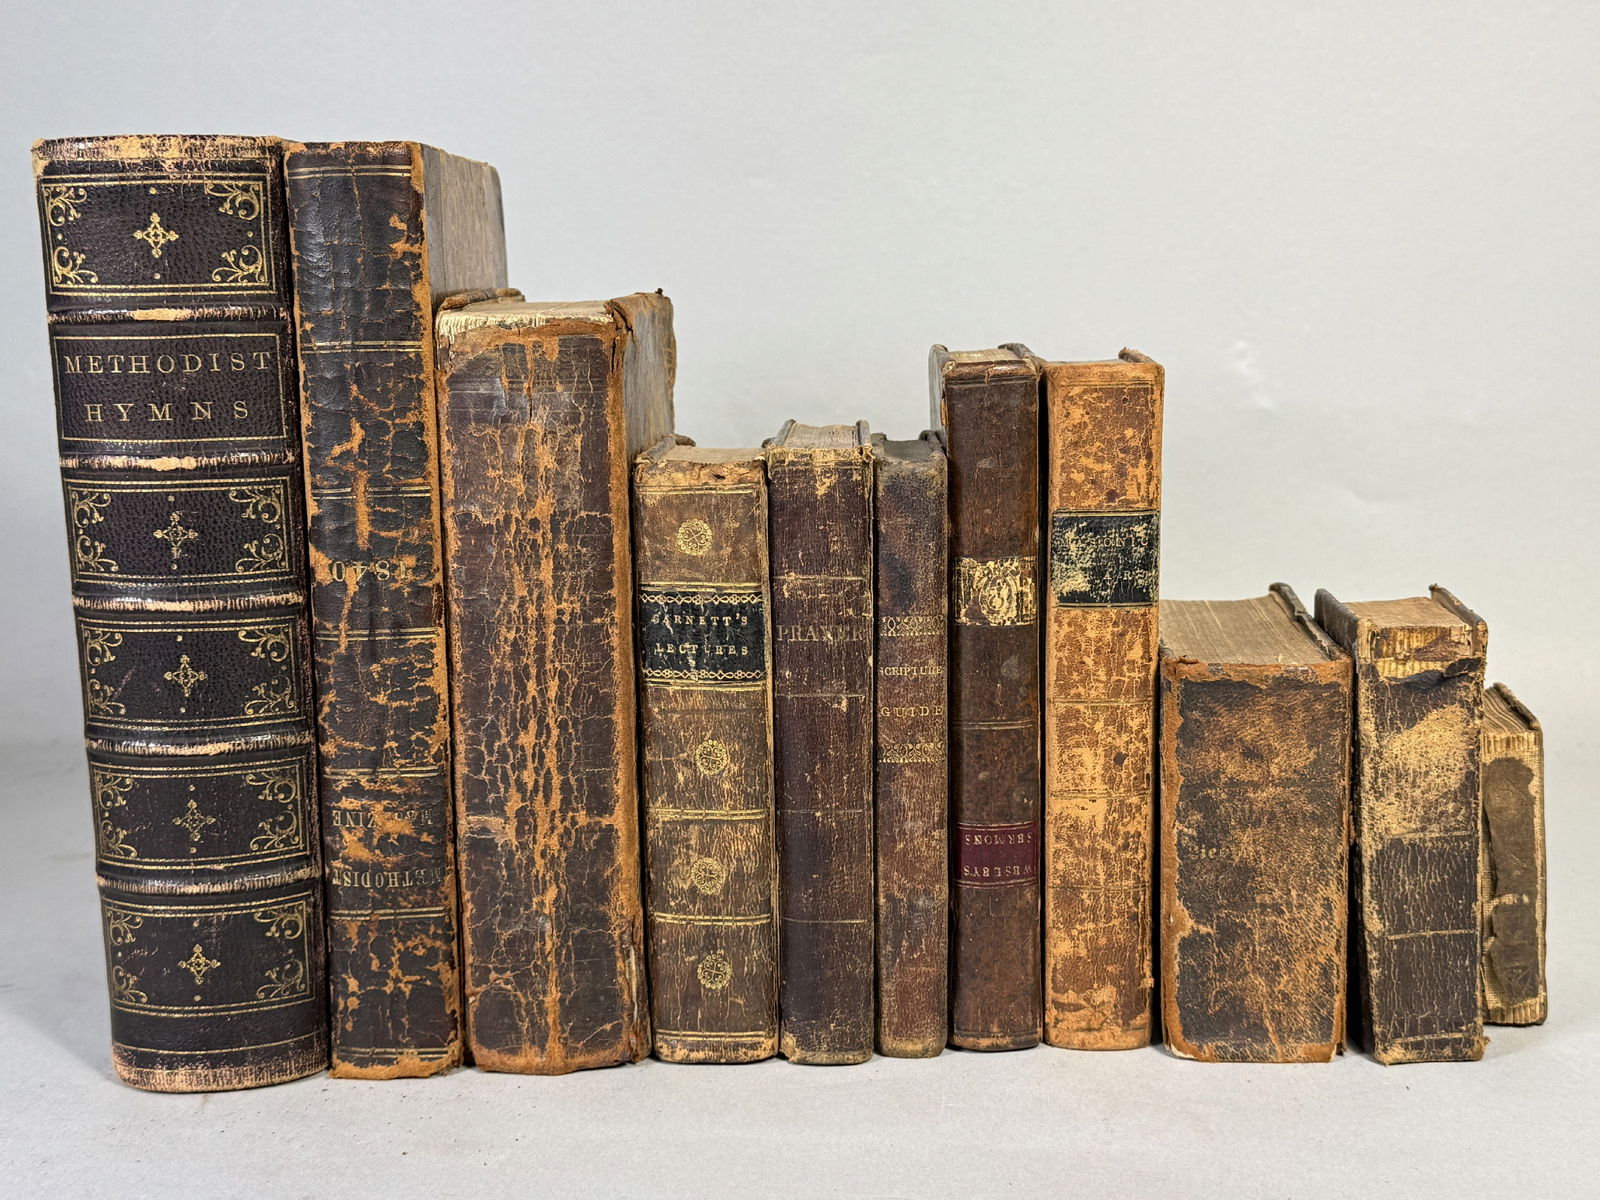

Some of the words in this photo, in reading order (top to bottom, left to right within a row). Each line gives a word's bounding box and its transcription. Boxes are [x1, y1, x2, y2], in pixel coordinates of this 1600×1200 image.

[64, 351, 271, 374] METHODIST
[84, 400, 249, 423] HYMNS
[331, 560, 407, 583] 1840
[651, 613, 748, 626] GARNETT'S
[655, 642, 748, 656] LECTURES
[881, 705, 943, 718] GUIDE
[965, 831, 1034, 846] SERMONS
[332, 867, 441, 889] METHODIST
